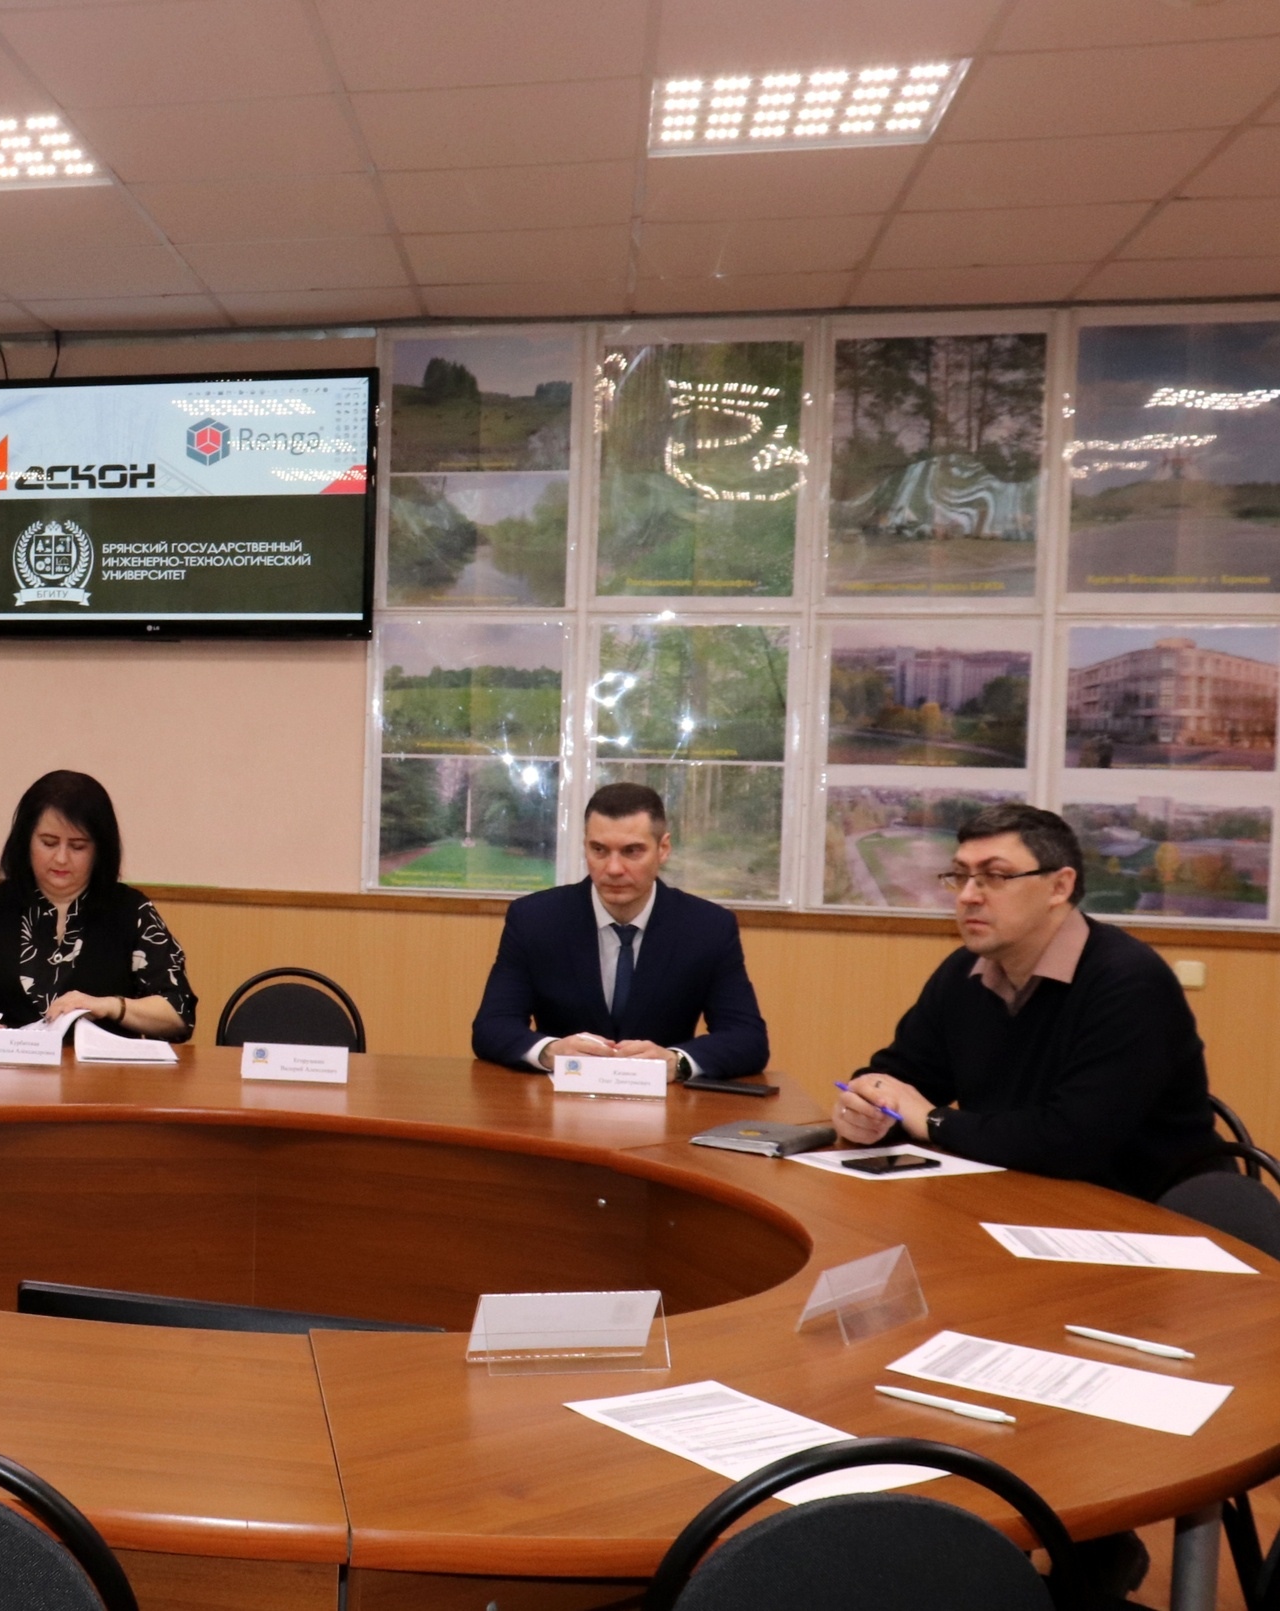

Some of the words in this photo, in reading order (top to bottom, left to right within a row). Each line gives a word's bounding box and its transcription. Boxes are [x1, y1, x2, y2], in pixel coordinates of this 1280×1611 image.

[239, 428, 321, 455] Renga
[102, 541, 168, 554] БРЯНСКИЙ
[171, 540, 303, 554] ГОСУДАРСТВЕННЫЙ
[102, 553, 311, 567] ИНЖЕНЕРНО-ТЕХНОЛОГИЧЕСКИЙ
[102, 569, 186, 581] УНИВЕРСИТЕТ
[36, 590, 69, 598] БГИТУ
